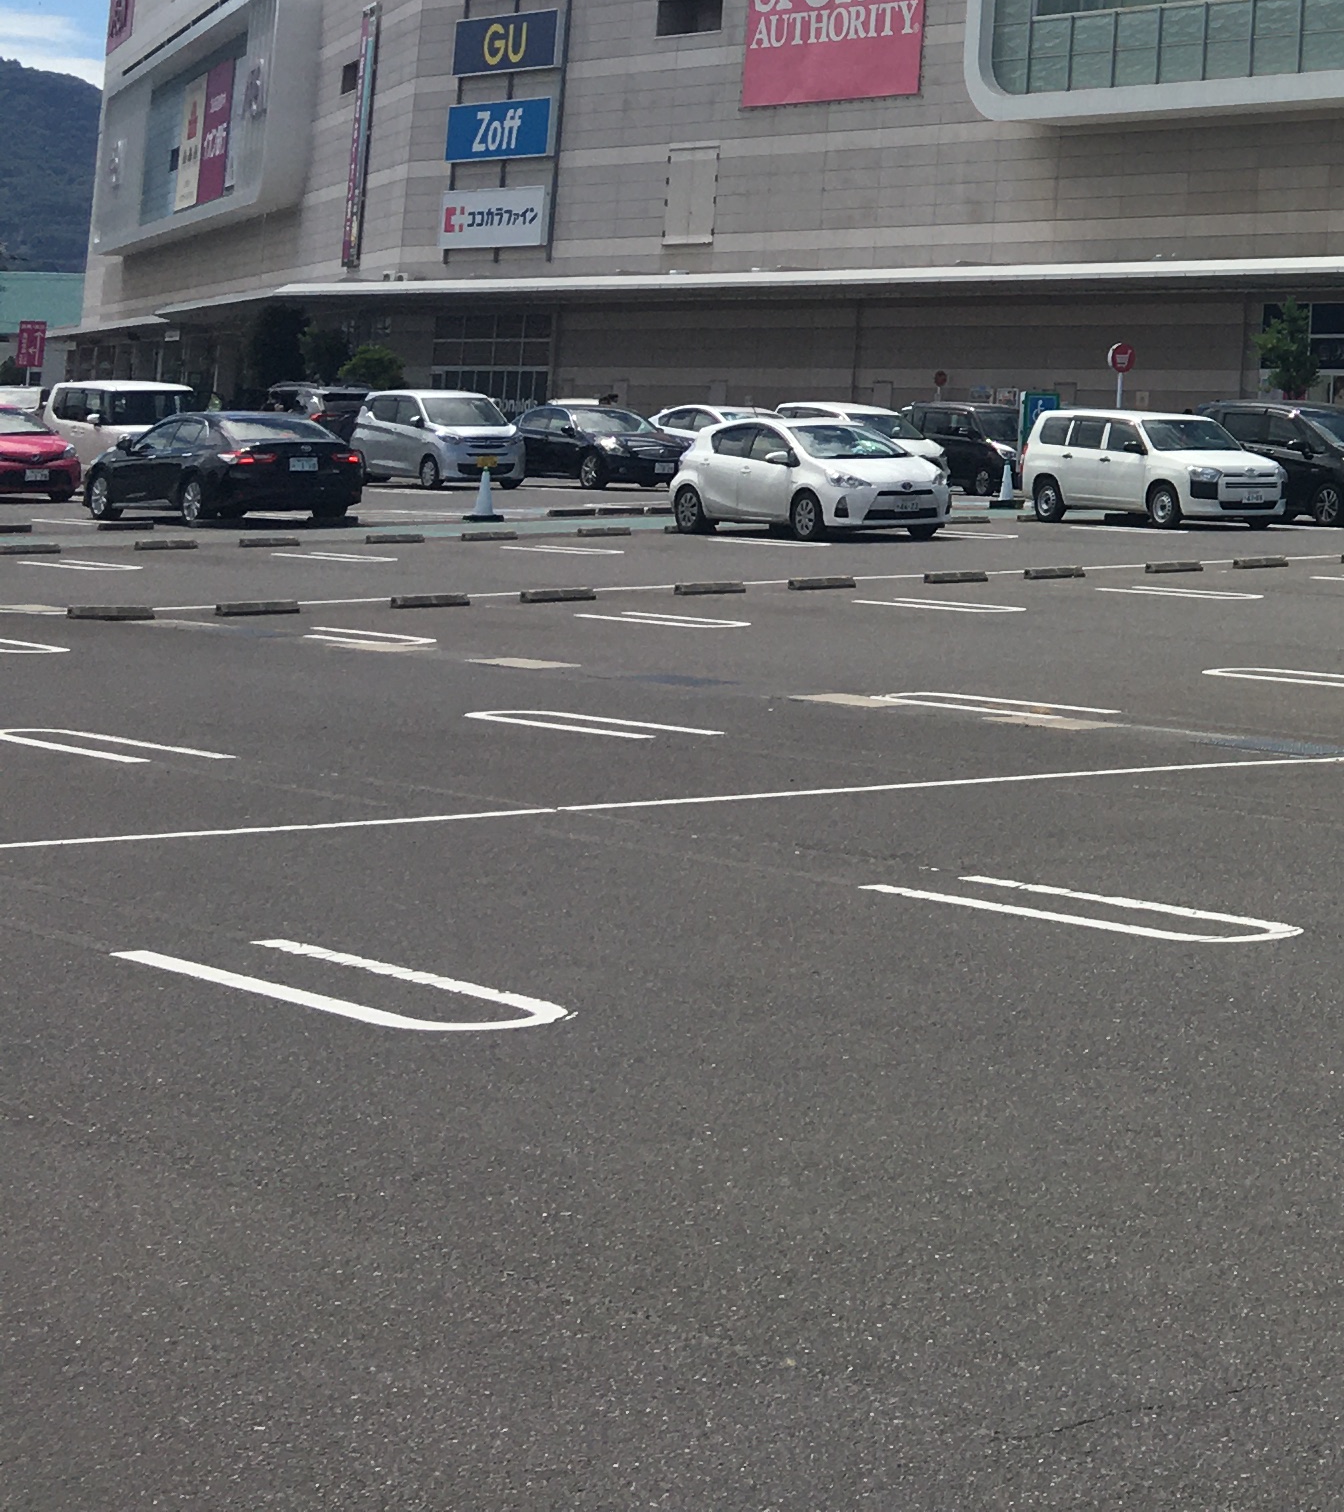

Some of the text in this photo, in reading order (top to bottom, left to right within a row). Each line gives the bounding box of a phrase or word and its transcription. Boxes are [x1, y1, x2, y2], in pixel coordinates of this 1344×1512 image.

[483, 22, 528, 66] GU
[750, 0, 919, 48] AUTHORITY
[472, 108, 523, 152] Zoff
[467, 207, 538, 227] ココカラファイン
